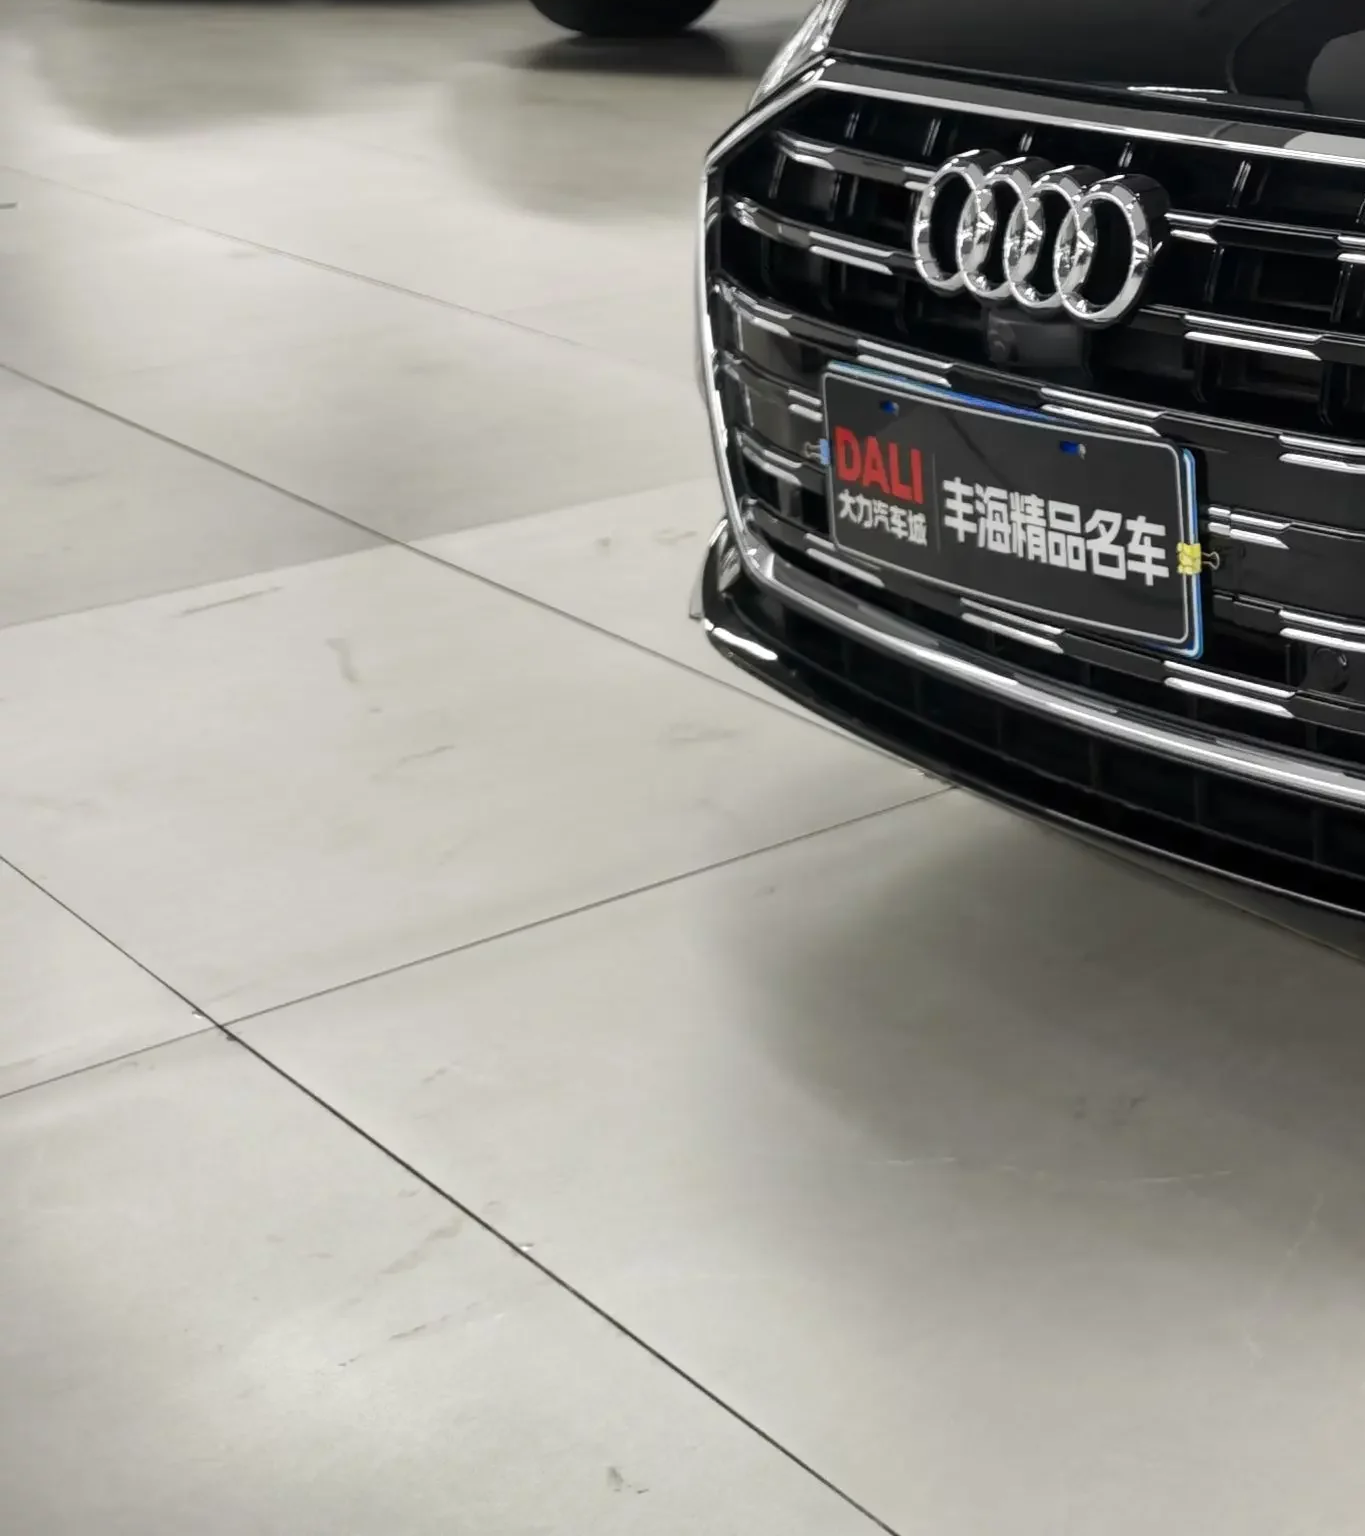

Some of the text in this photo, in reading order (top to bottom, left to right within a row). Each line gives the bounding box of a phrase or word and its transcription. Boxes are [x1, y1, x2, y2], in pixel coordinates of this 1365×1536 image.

[834, 425, 924, 505] DALI
[837, 489, 928, 547] 大力汽车城
[942, 476, 1170, 587] 丰海精品名车
